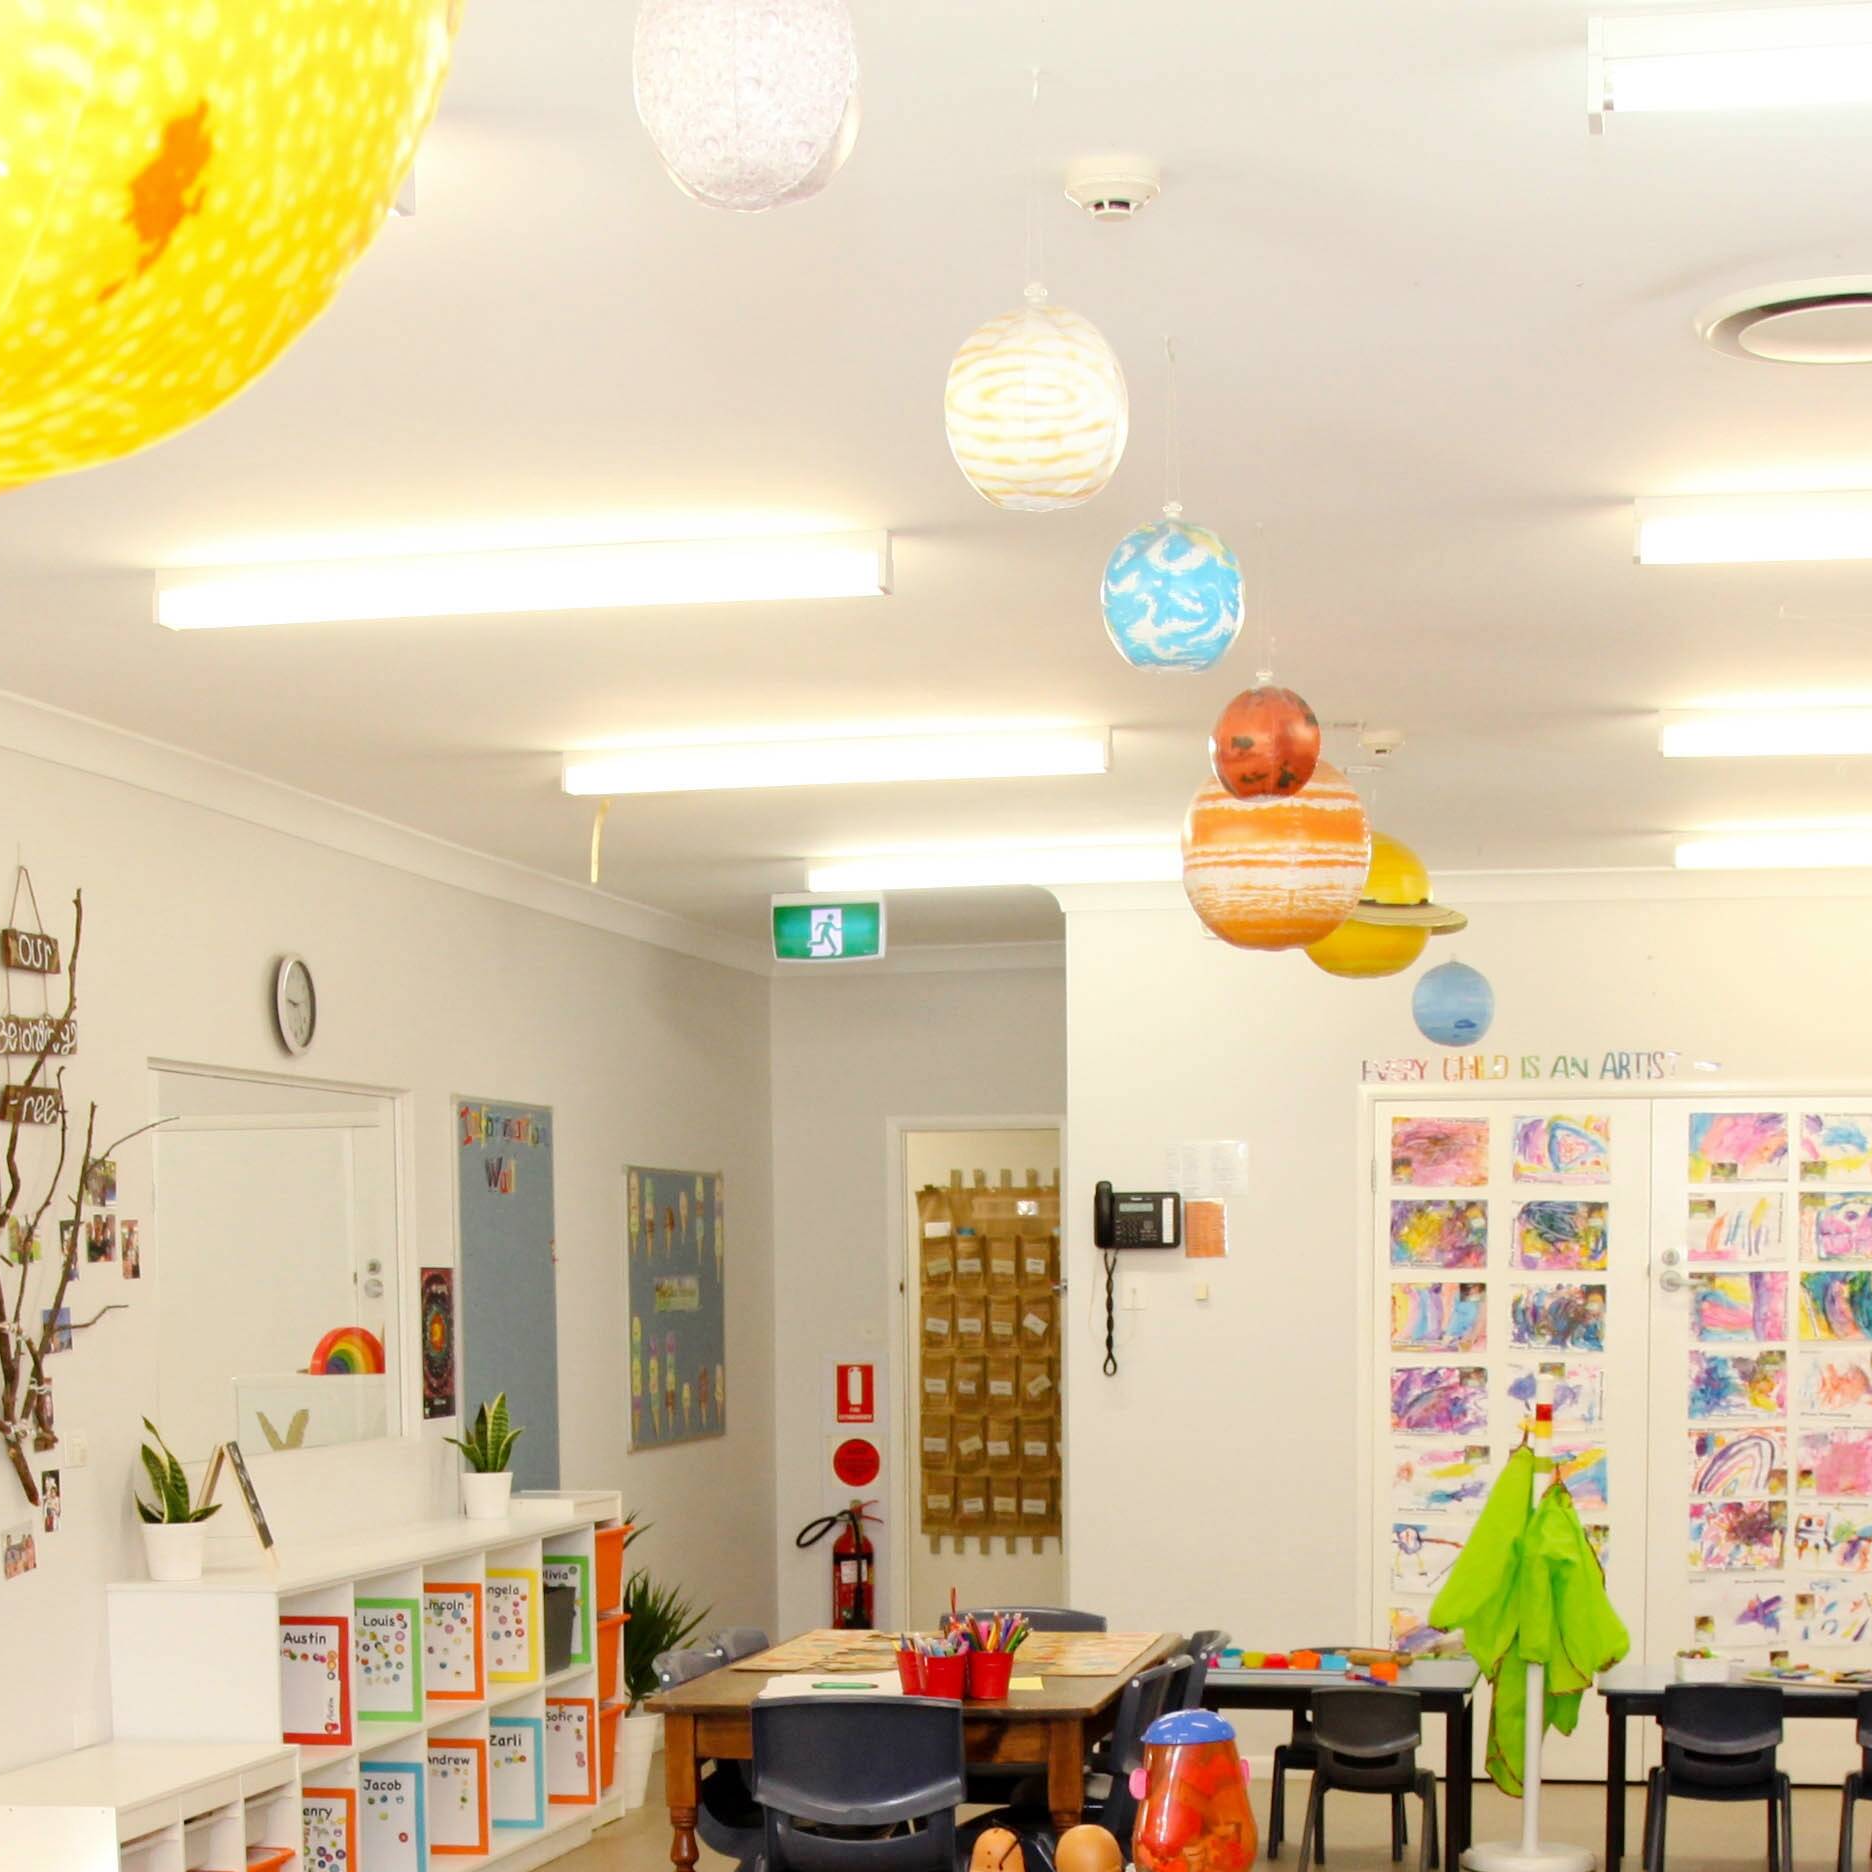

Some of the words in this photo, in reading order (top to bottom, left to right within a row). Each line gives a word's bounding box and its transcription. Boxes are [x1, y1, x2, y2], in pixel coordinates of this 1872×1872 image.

[1442, 1056, 1510, 1082] CHILD
[1521, 1056, 1540, 1080] IS
[1549, 1055, 1590, 1080] AN
[1599, 1051, 1681, 1081] ARTIST
[9, 1095, 58, 1124] ree
[543, 1569, 569, 1580] livia
[486, 1584, 520, 1598] ngela
[362, 1615, 396, 1628] Louis
[283, 1631, 327, 1646] Austin
[362, 1779, 403, 1792] Jacob
[302, 1808, 333, 1820] enry
